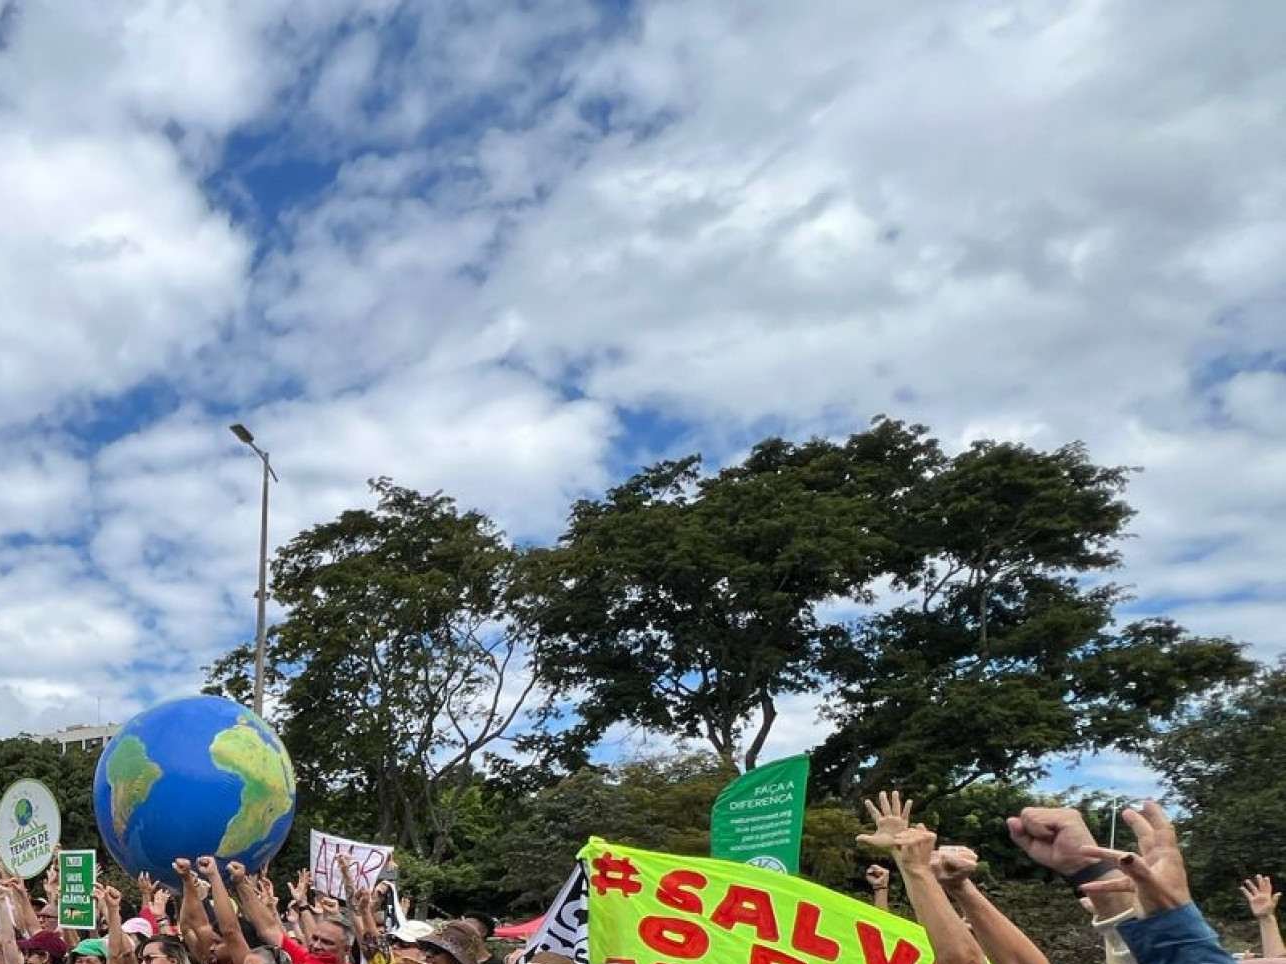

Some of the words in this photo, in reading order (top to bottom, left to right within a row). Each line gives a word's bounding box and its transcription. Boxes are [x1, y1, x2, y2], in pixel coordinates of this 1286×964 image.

[754, 783, 785, 796] FAÇA
[729, 792, 794, 811] DIFERENÇA
[10, 836, 38, 856] TEMPO
[38, 830, 50, 845] DE
